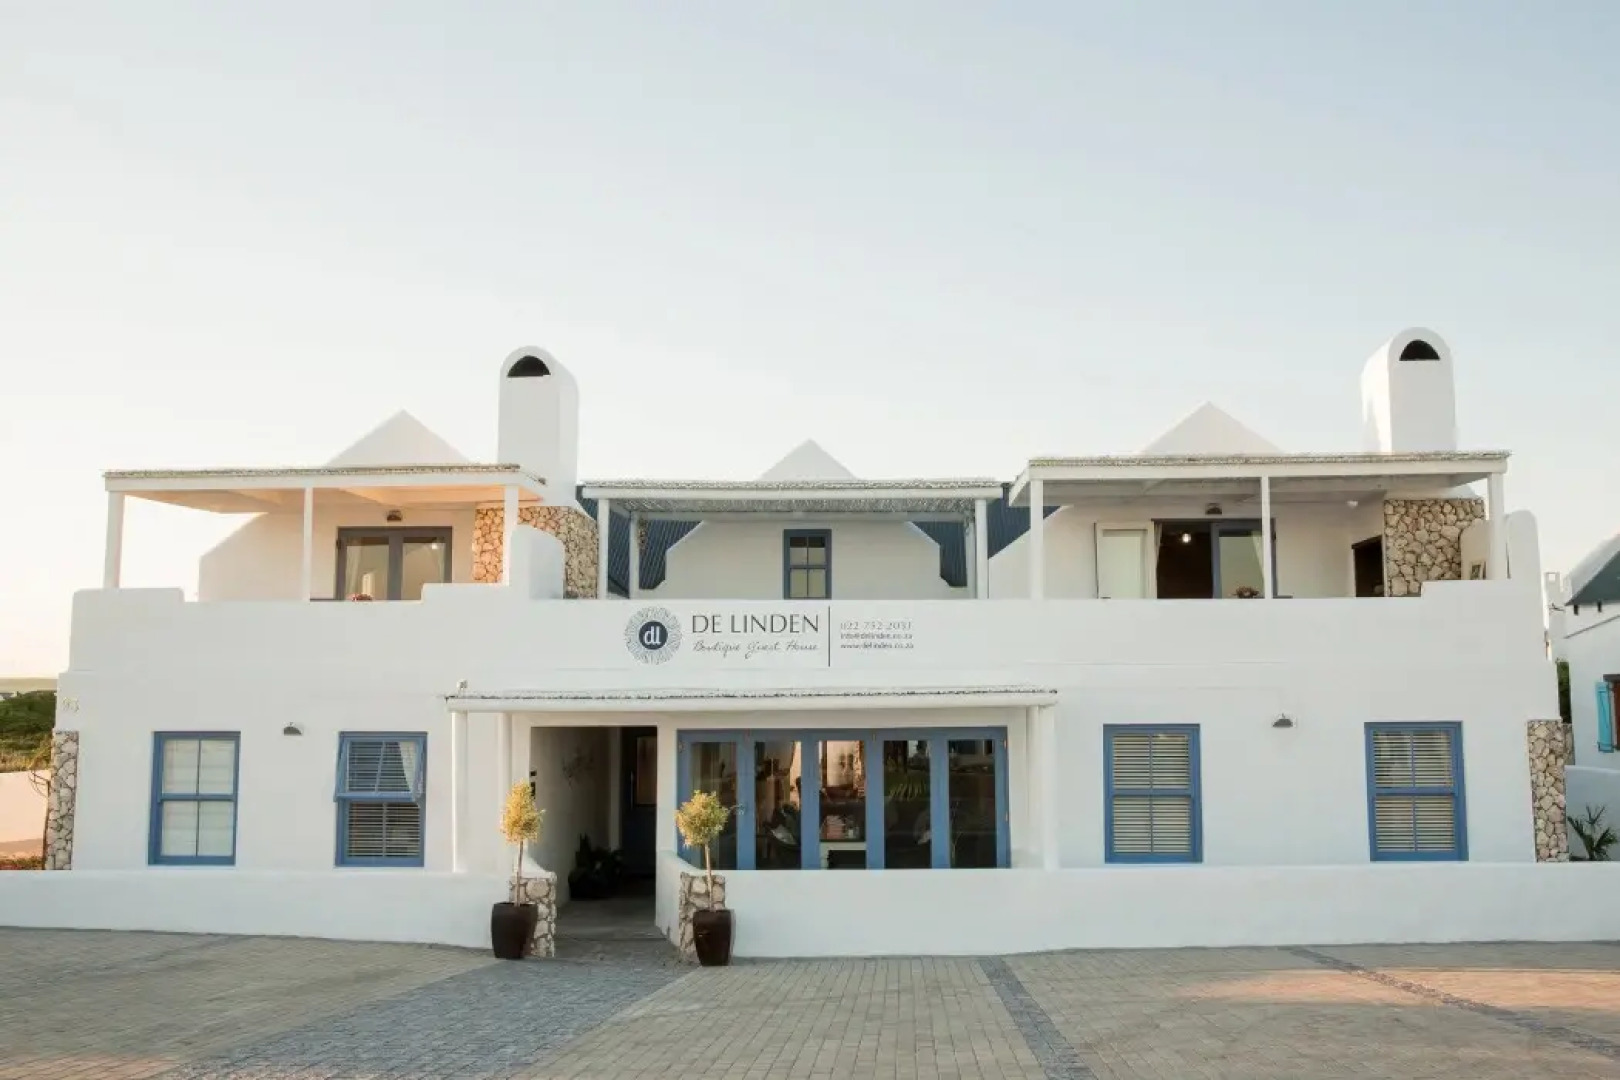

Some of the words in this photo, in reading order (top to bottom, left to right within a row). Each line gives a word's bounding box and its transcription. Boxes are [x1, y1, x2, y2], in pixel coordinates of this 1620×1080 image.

[692, 613, 722, 634] DE
[731, 613, 819, 634] LINDEN
[643, 625, 661, 645] dl
[693, 640, 741, 658] Boutique
[745, 640, 781, 660] Guest
[786, 639, 819, 652] House
